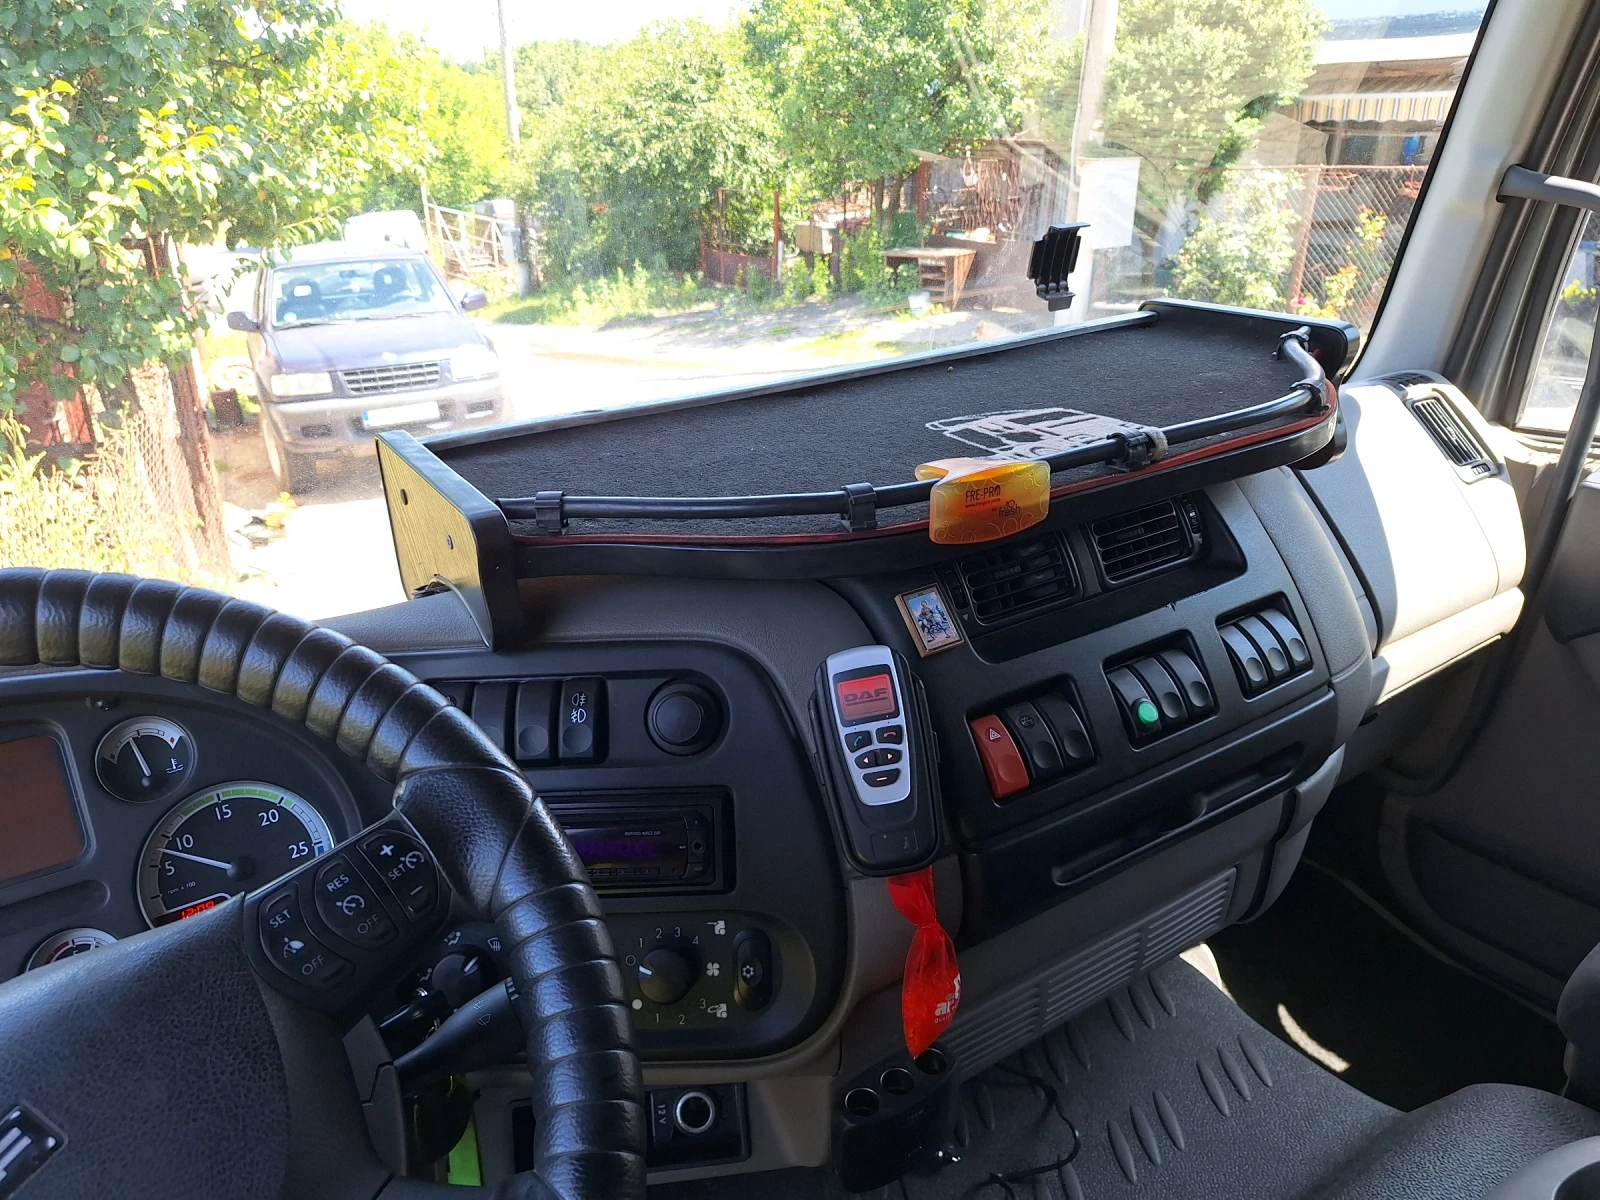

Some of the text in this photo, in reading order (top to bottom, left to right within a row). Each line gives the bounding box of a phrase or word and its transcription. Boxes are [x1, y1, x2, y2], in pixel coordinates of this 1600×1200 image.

[998, 503, 1021, 518] fresh
[843, 687, 888, 703] DAF
[215, 804, 232, 821] 15
[258, 809, 279, 826] 20
[176, 834, 194, 850] 10
[288, 841, 309, 859] 25
[164, 860, 176, 876] 5
[388, 864, 406, 881] SET
[186, 881, 196, 890] 100
[326, 873, 350, 893] RES
[269, 909, 291, 929] SET
[357, 914, 380, 934] OFF
[638, 927, 699, 948] 1 2 3 4
[301, 955, 325, 976] OFF
[655, 998, 706, 1025] 1 2 3
